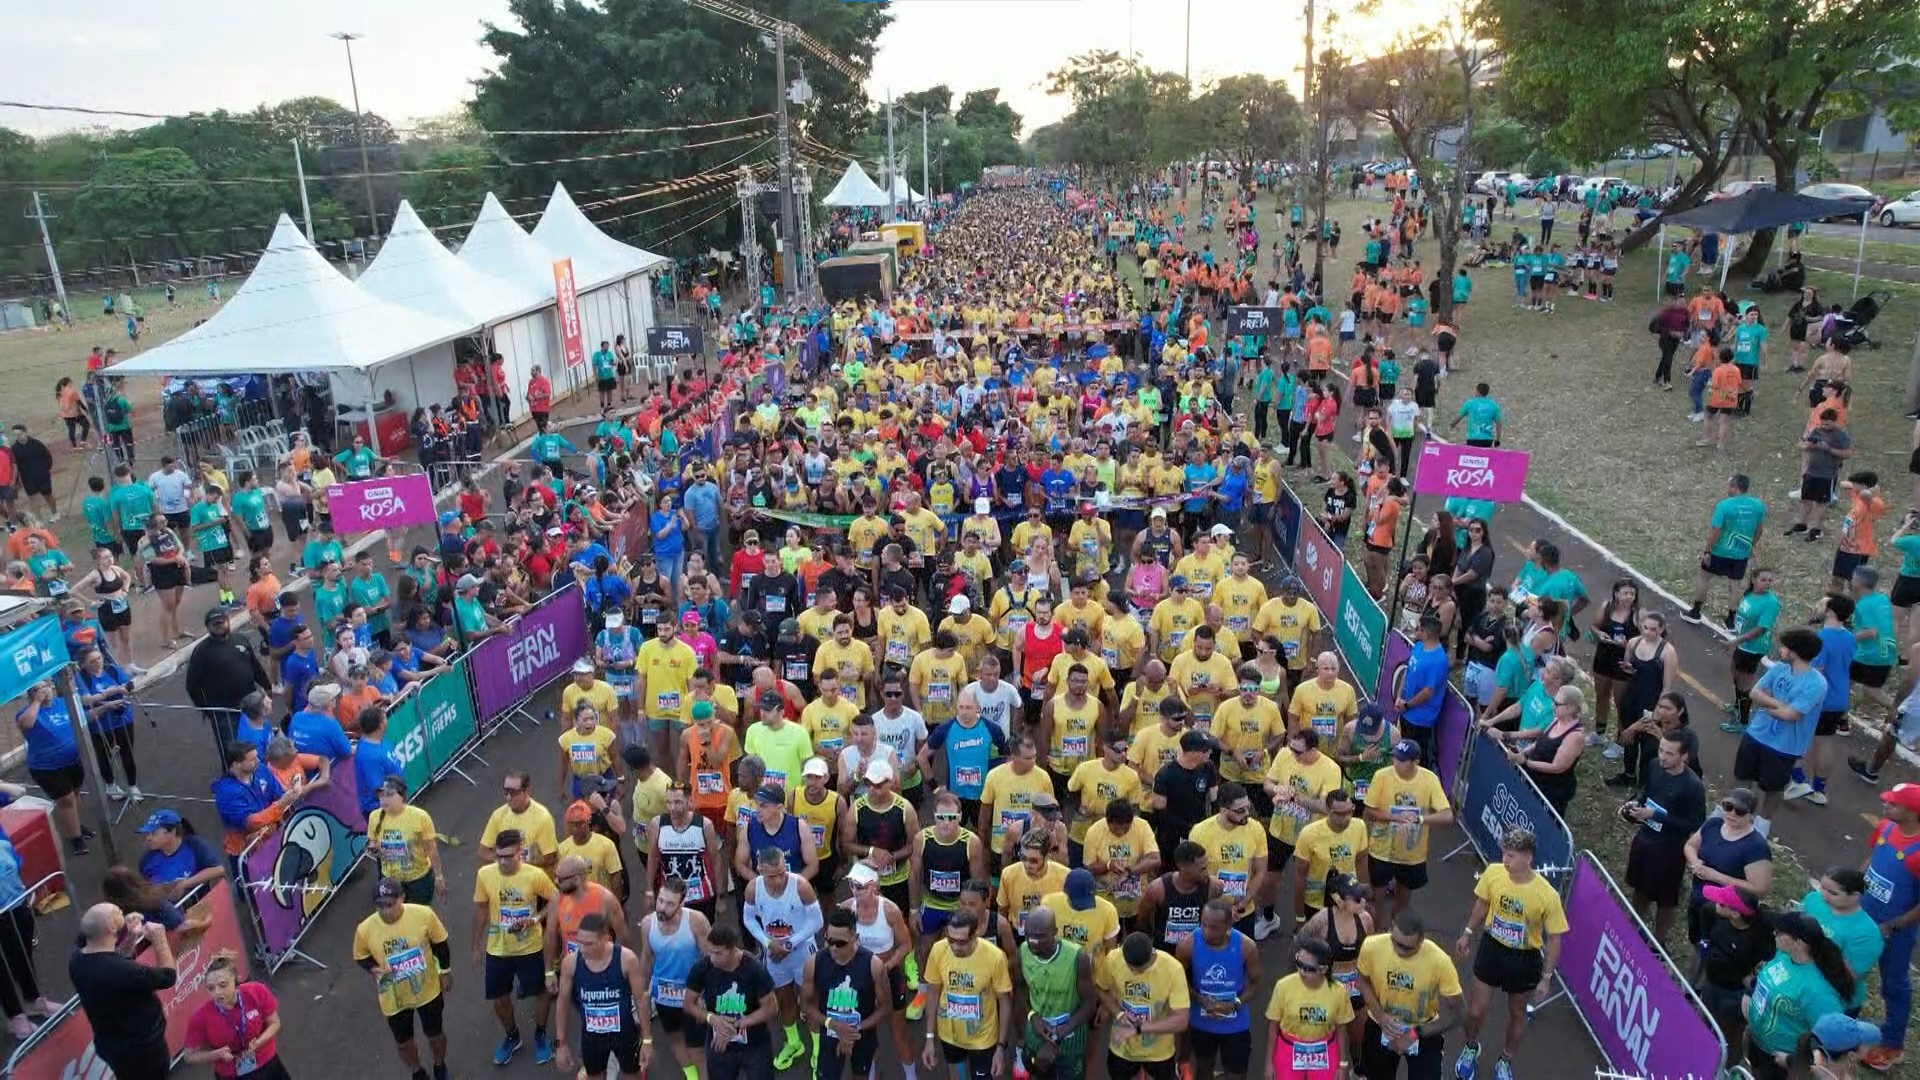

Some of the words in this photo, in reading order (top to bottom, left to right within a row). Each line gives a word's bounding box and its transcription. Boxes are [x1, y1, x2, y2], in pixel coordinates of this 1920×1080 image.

[1240, 316, 1270, 330] PRETA
[660, 333, 691, 349] PRETA
[1446, 468, 1495, 488] ROSA
[358, 496, 406, 521] ROSA
[1344, 598, 1360, 637] SESI
[432, 703, 457, 739] FIEMS
[1596, 931, 1660, 1040] PAN
